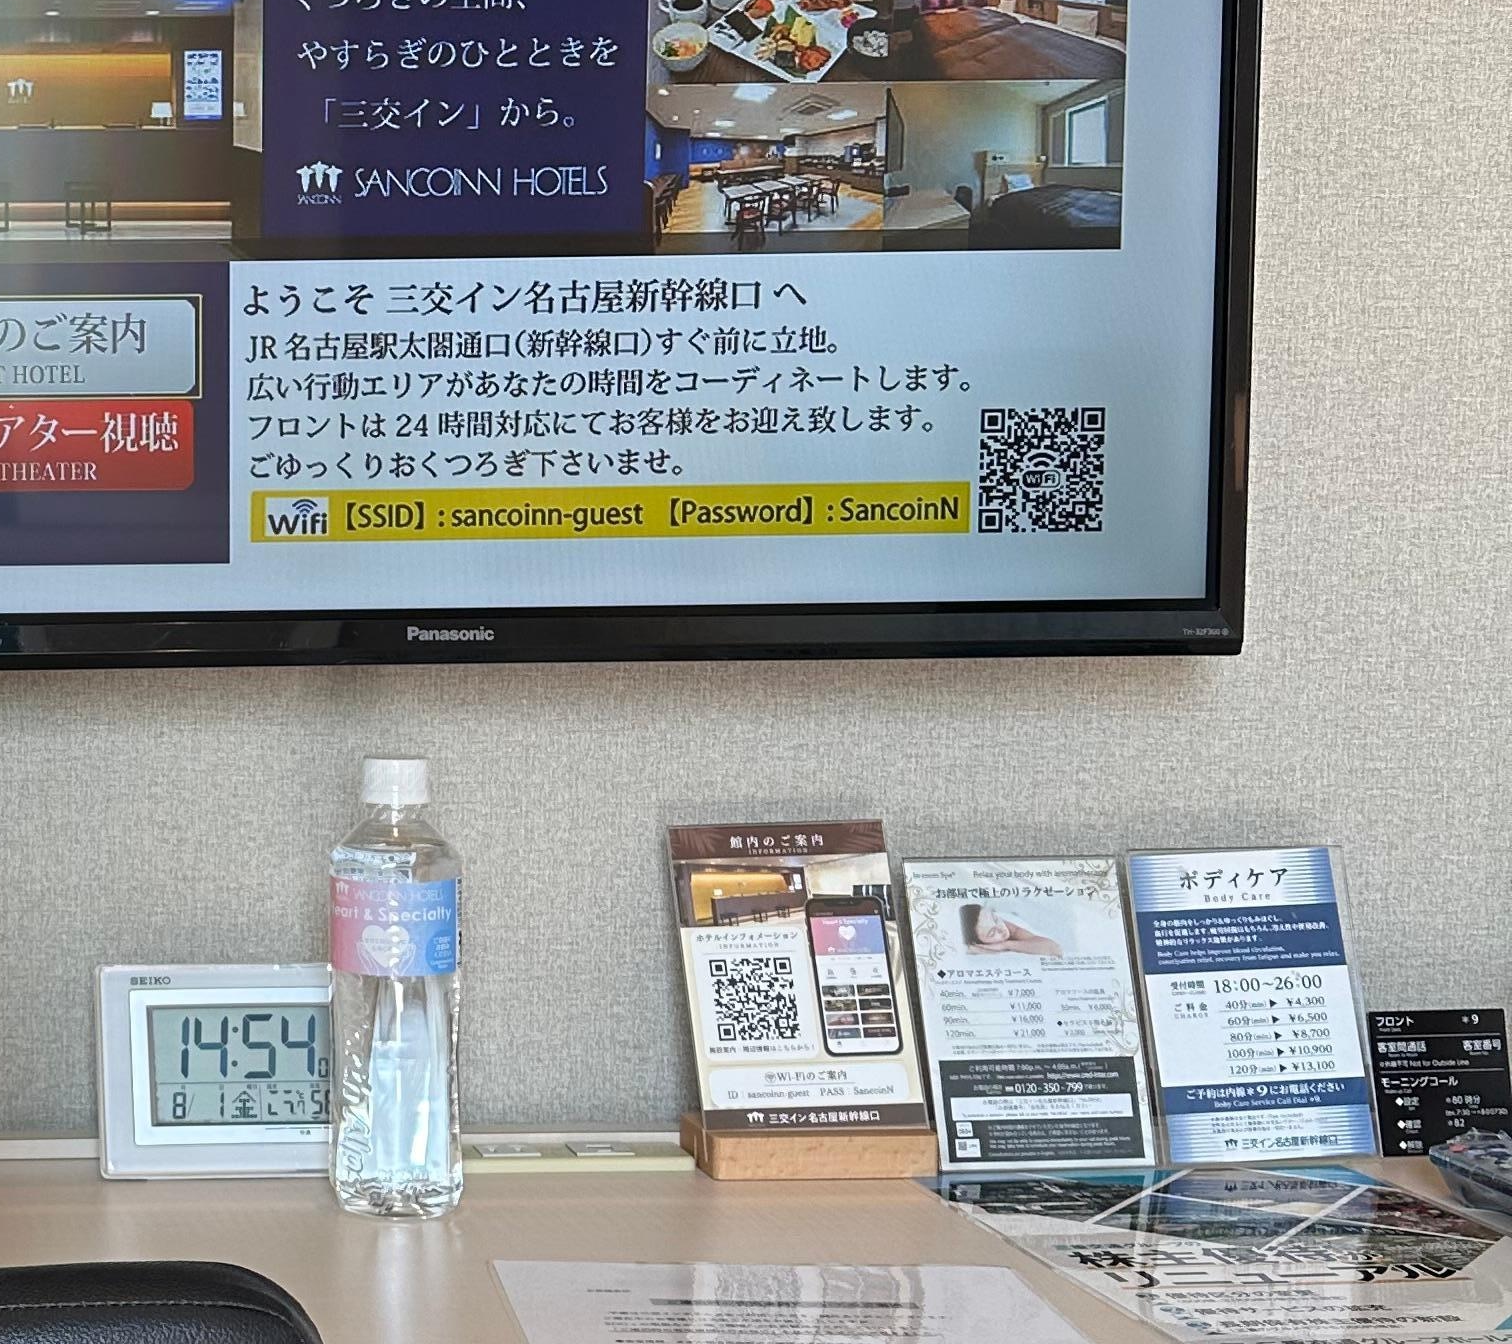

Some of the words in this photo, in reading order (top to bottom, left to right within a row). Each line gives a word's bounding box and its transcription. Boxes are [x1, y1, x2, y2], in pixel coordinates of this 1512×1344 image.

[296, 36, 619, 71] やすらぎのひとときを
[513, 164, 609, 197] HOTELS
[242, 284, 376, 318] ようこそ
[385, 277, 762, 317] 三交イン名古屋新幹線口
[245, 335, 278, 364] JR
[11, 363, 87, 385] HOTEL
[395, 412, 429, 439] 24
[248, 449, 685, 481] ごゆっくりおくつろぎ下さいませ。
[450, 501, 644, 532] sancoinn-guest
[839, 495, 960, 523] SancoinN
[406, 626, 495, 643] Panasonic
[729, 833, 824, 849] 館内のご案内
[748, 847, 808, 855] INFORMATION
[1179, 867, 1289, 890] ボディケア
[1203, 892, 1235, 904] Body
[1241, 891, 1272, 902] Care
[332, 905, 359, 919] eart
[363, 907, 374, 921] &
[695, 931, 799, 943] ホテルインフォメーション
[129, 975, 172, 986] SEIKO
[1170, 979, 1205, 991] 受付時間
[1375, 1015, 1415, 1027] フロント
[180, 1013, 316, 1079] 14:54
[819, 1087, 845, 1097] PASS
[1381, 1075, 1459, 1088] モーニングコール
[231, 1090, 258, 1119] 金
[768, 1110, 881, 1125] 三交イン名古屋新幹線口
[1067, 1245, 1385, 1269] 株主優待が
[1100, 1263, 1460, 1289] リニューアル
